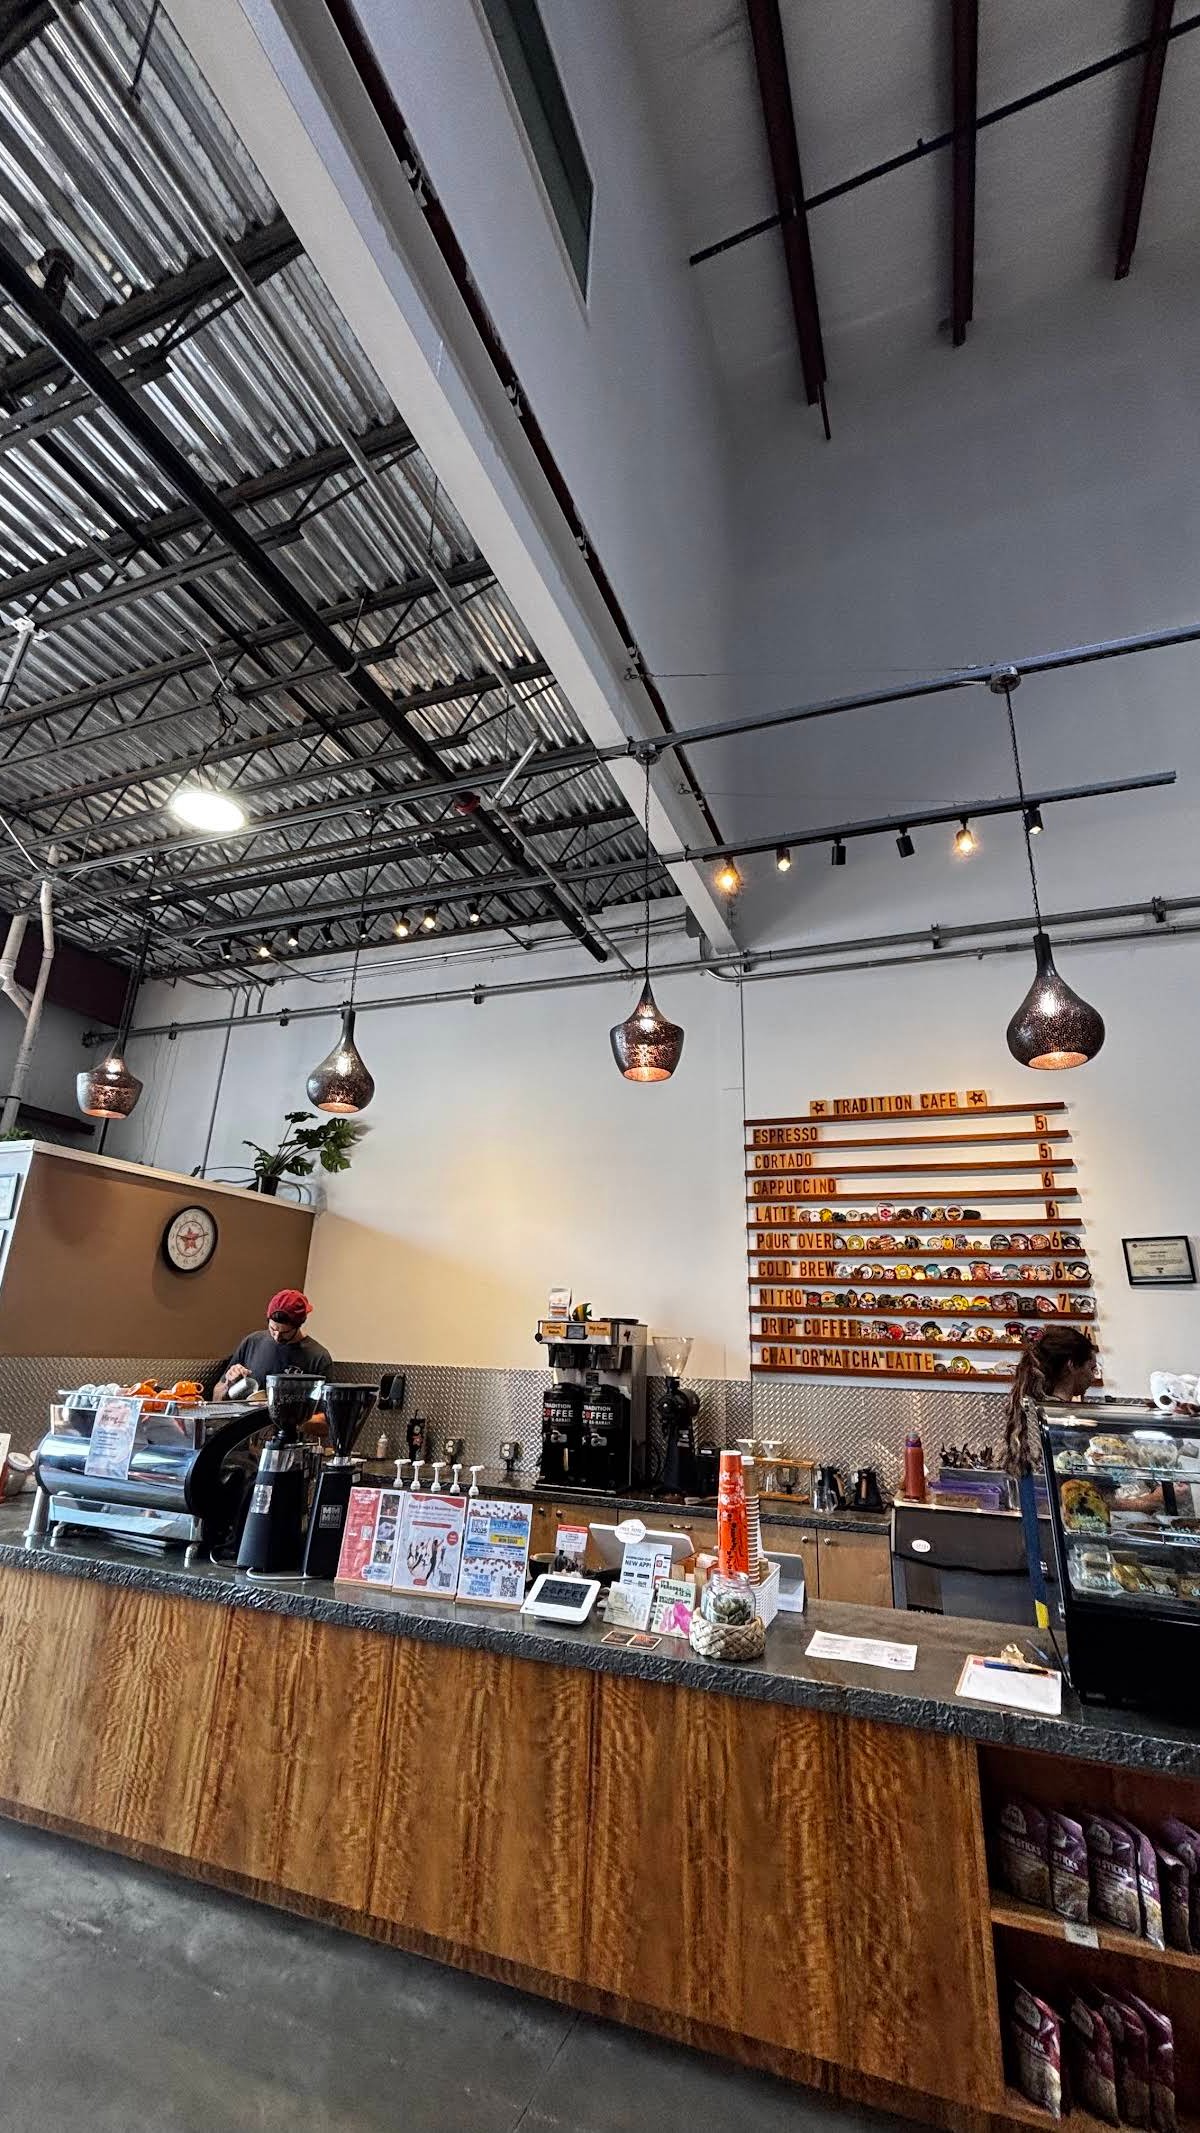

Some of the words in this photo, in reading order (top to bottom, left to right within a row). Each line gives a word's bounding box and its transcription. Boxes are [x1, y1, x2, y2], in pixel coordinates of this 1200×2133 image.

[835, 1096, 912, 1114] TRADITION
[921, 1093, 956, 1109] CAFE
[754, 1127, 818, 1143] ESPRESSO
[1036, 1115, 1044, 1130] 5
[755, 1153, 812, 1169] CORTADO
[1040, 1143, 1048, 1159] 5
[754, 1178, 836, 1195] CAPPUCCINO
[1044, 1172, 1052, 1187] 6
[756, 1206, 796, 1221] LATTE
[1048, 1201, 1055, 1217] 6
[757, 1233, 789, 1249] POUR
[798, 1233, 832, 1249] OVER
[1052, 1232, 1060, 1247] 6
[759, 1261, 791, 1277] COLD
[801, 1261, 835, 1277] BREW
[1056, 1263, 1063, 1279] 6
[760, 1289, 802, 1305] NITRO
[1059, 1294, 1067, 1310] 7
[761, 1317, 795, 1334] DRIP
[804, 1319, 858, 1336] COFFEE
[761, 1347, 793, 1364] CHAI
[802, 1350, 819, 1366] OR
[823, 1351, 880, 1368] MATCHA
[886, 1352, 932, 1371] LATTE
